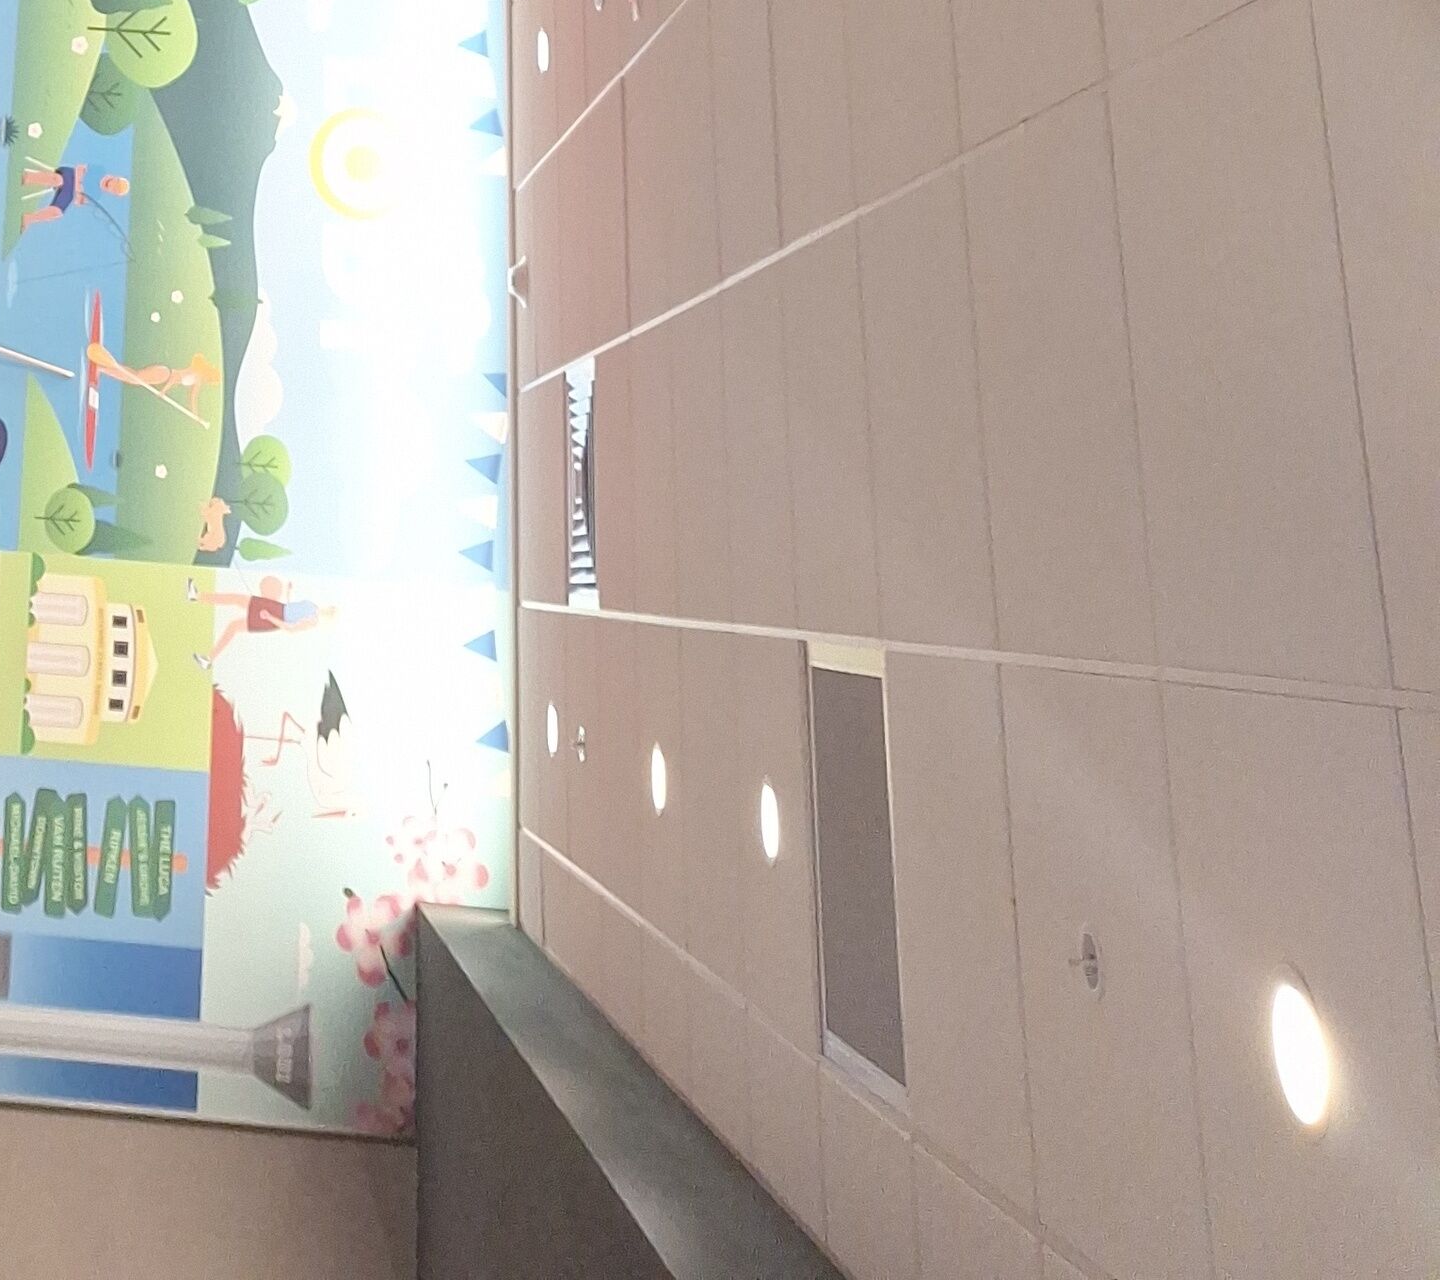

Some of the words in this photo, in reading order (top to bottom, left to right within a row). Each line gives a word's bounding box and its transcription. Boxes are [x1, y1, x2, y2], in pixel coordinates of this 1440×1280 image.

[27, 816, 47, 889] DOWNTOWN
[53, 816, 65, 845] VAN
[159, 826, 172, 854] THE
[74, 852, 84, 901] VISITOR
[103, 829, 122, 884] RIPKEN
[158, 857, 170, 896] LUCA
